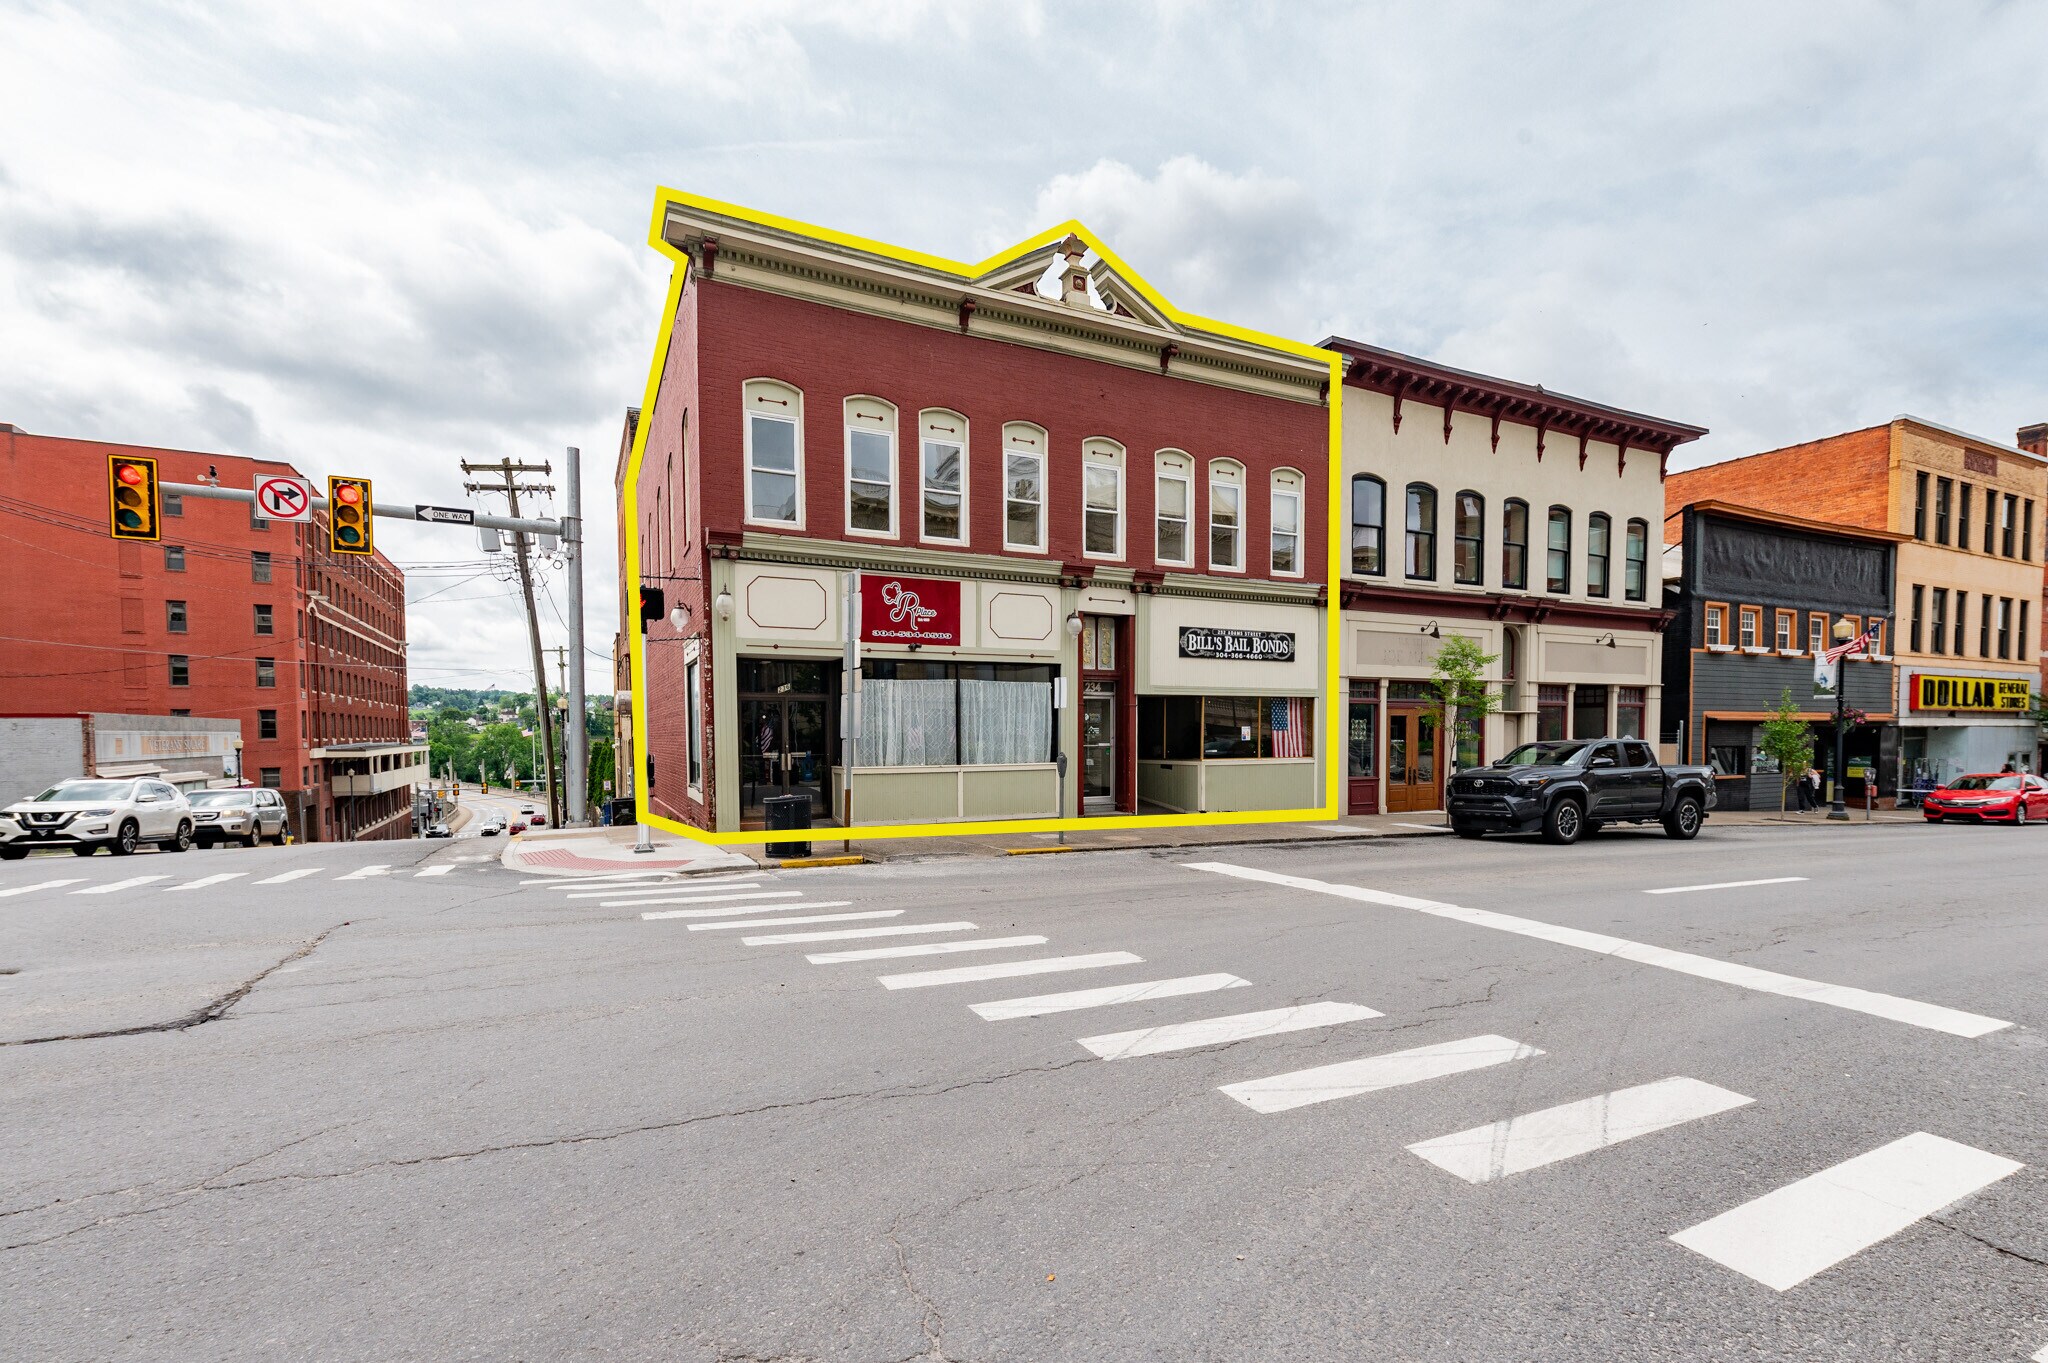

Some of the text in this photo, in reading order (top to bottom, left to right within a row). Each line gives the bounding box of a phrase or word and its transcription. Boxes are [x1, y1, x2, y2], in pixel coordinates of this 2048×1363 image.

[433, 511, 467, 520] ONE WAY
[915, 606, 937, 617] Place
[1188, 634, 1289, 654] BILL'S BAIL BONDS
[1085, 682, 1101, 692] 234
[1923, 678, 1995, 707] DOLLAR
[1999, 682, 2028, 694] GENERAL
[2001, 696, 2026, 709] STORES
